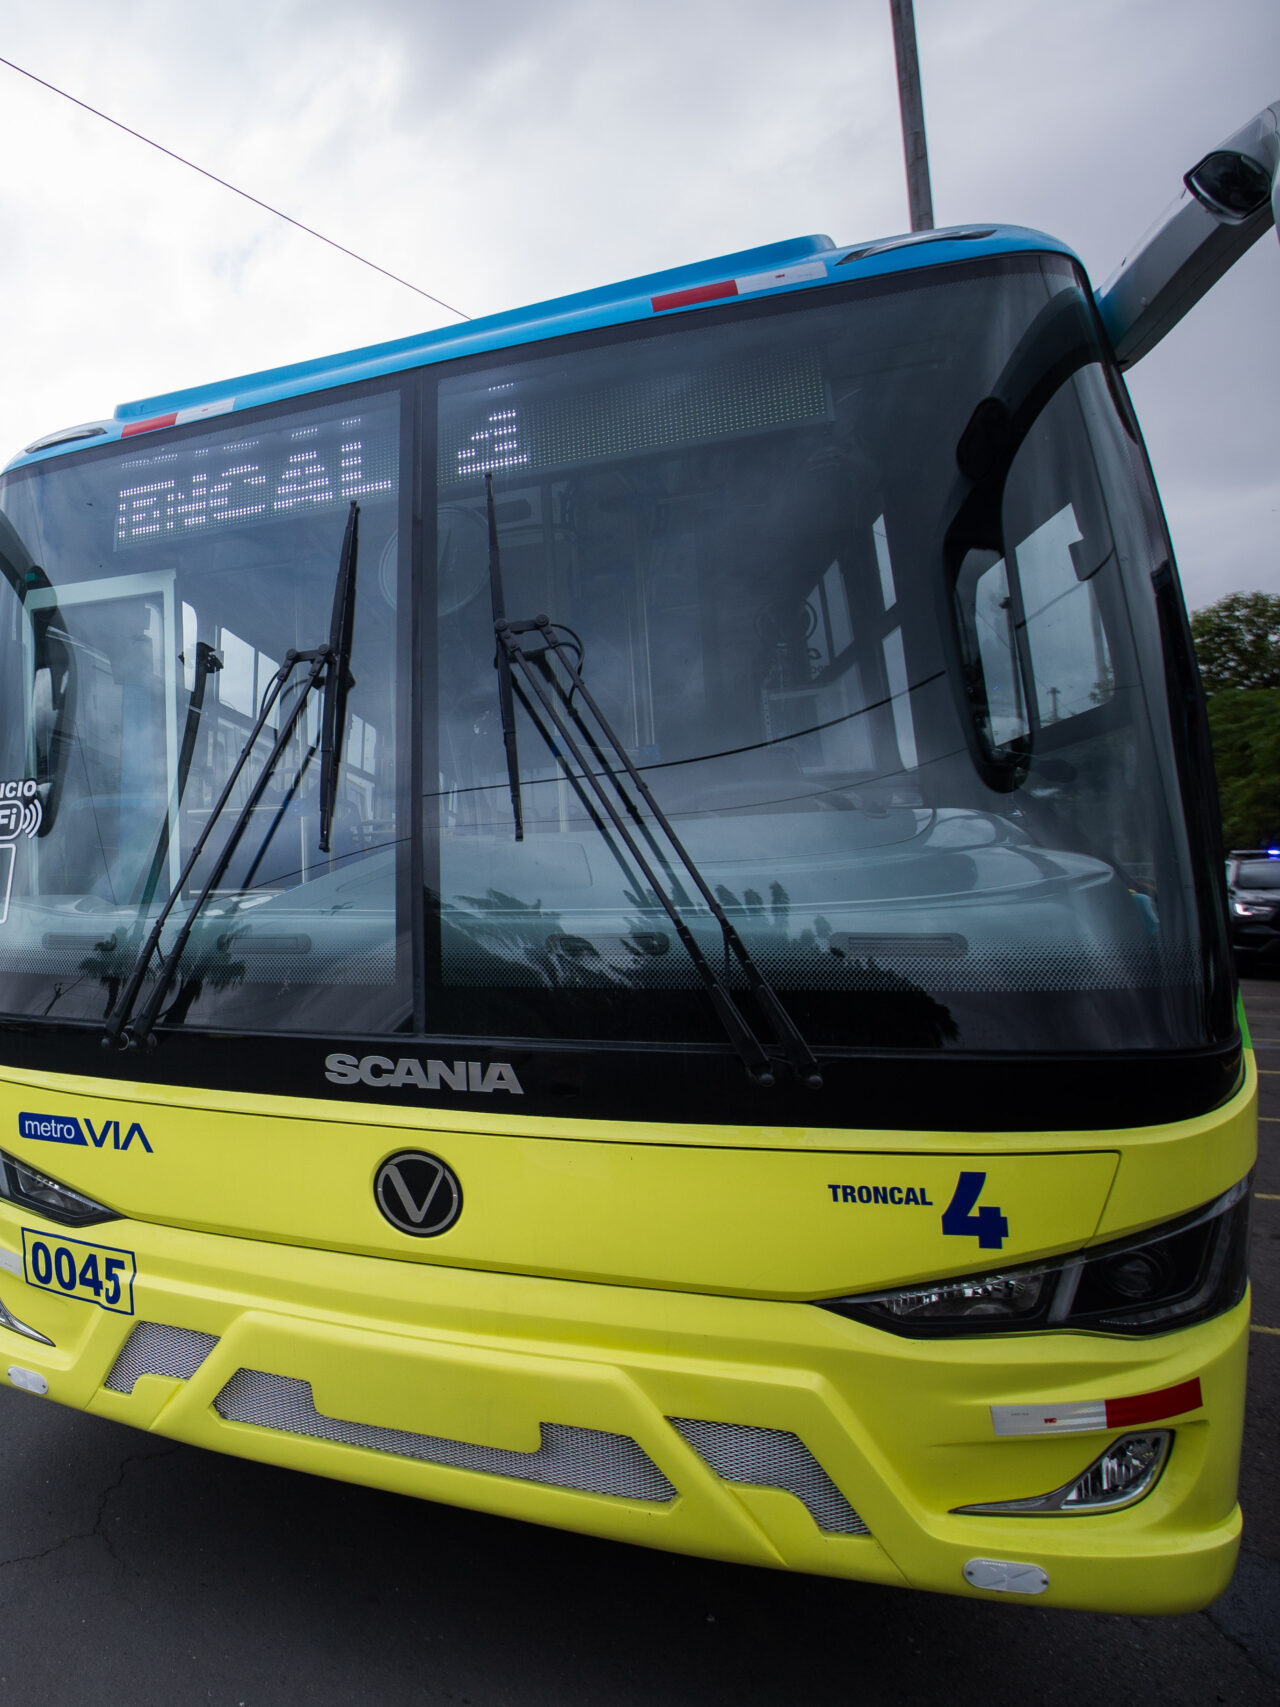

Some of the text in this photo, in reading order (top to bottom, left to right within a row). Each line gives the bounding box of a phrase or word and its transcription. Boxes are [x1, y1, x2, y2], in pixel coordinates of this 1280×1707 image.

[324, 1053, 525, 1094] SCANIA
[827, 1171, 1009, 1250] TRONCAL 4
[31, 1241, 126, 1305] 0045
